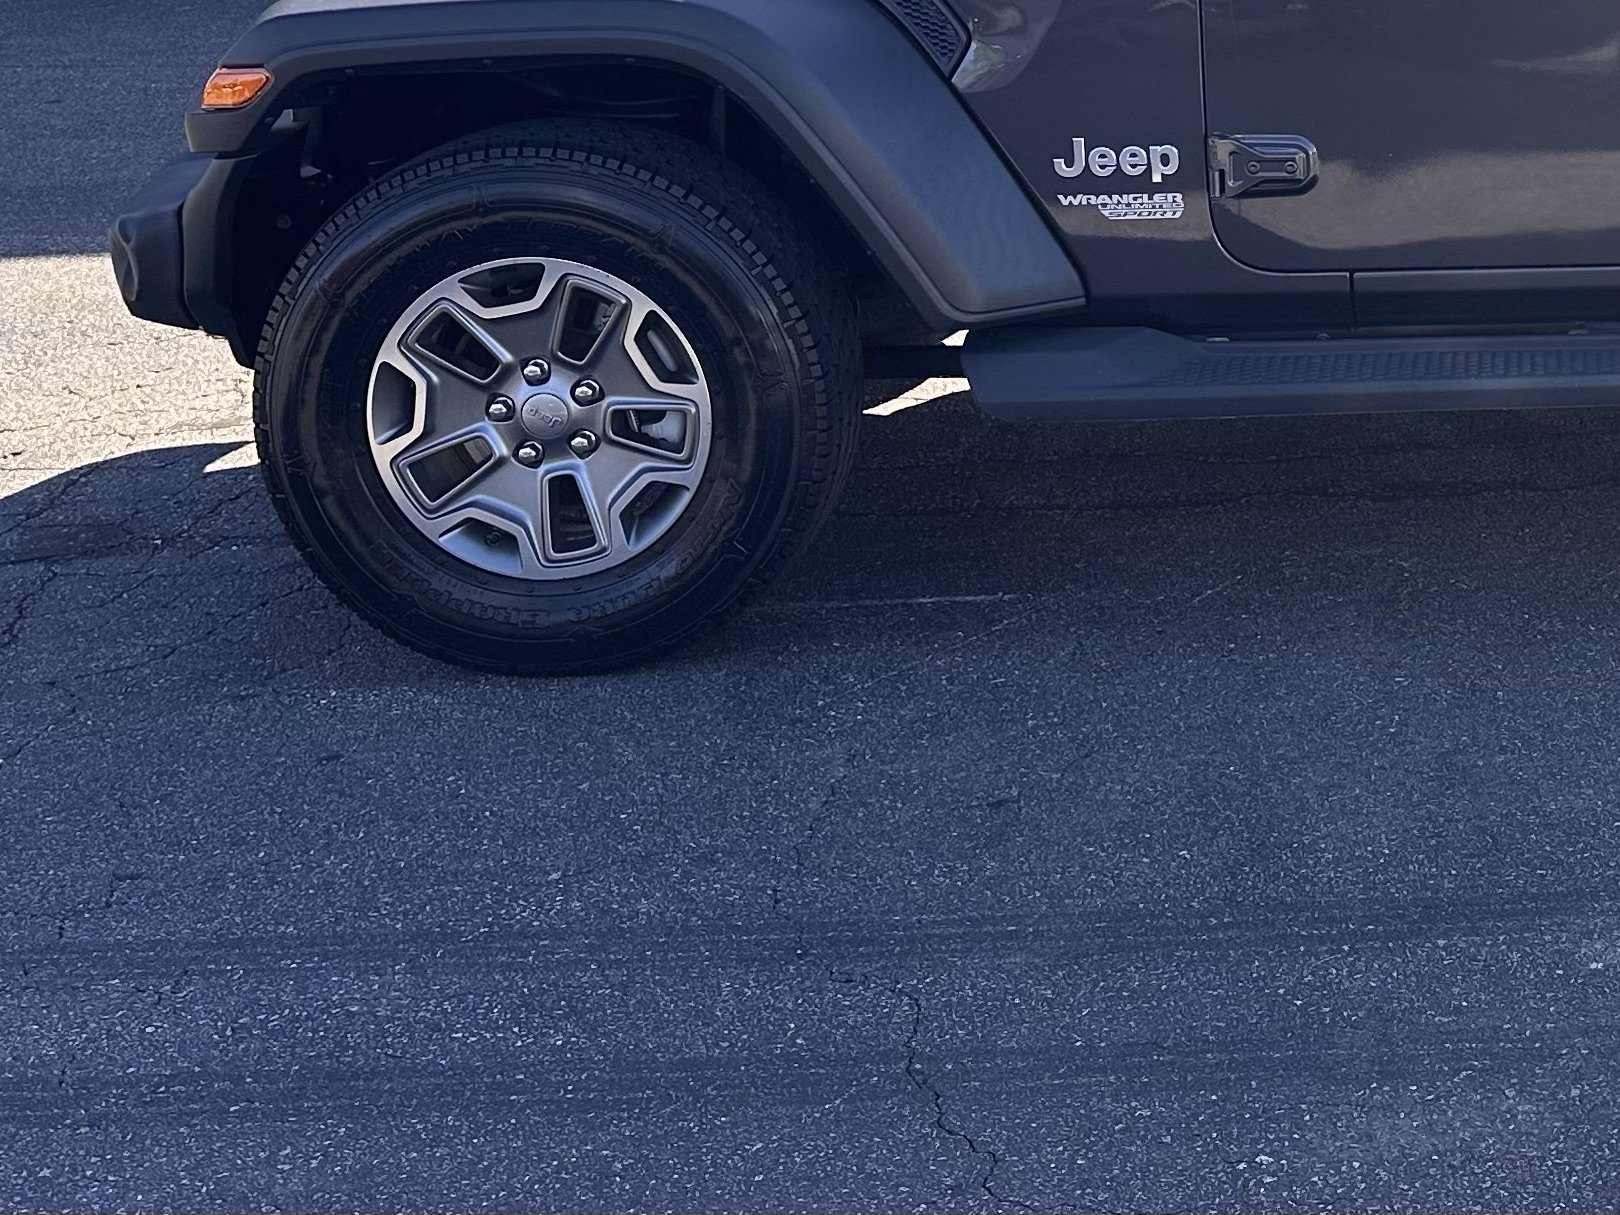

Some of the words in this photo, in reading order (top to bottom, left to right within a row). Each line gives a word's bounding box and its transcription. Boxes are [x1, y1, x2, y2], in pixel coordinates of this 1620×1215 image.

[1053, 137, 1179, 183] Jeep
[1057, 193, 1183, 206] WRANGLER
[1097, 202, 1185, 211] UNLIMITED
[1107, 210, 1179, 219] SPORT
[528, 406, 562, 427] Jeep
